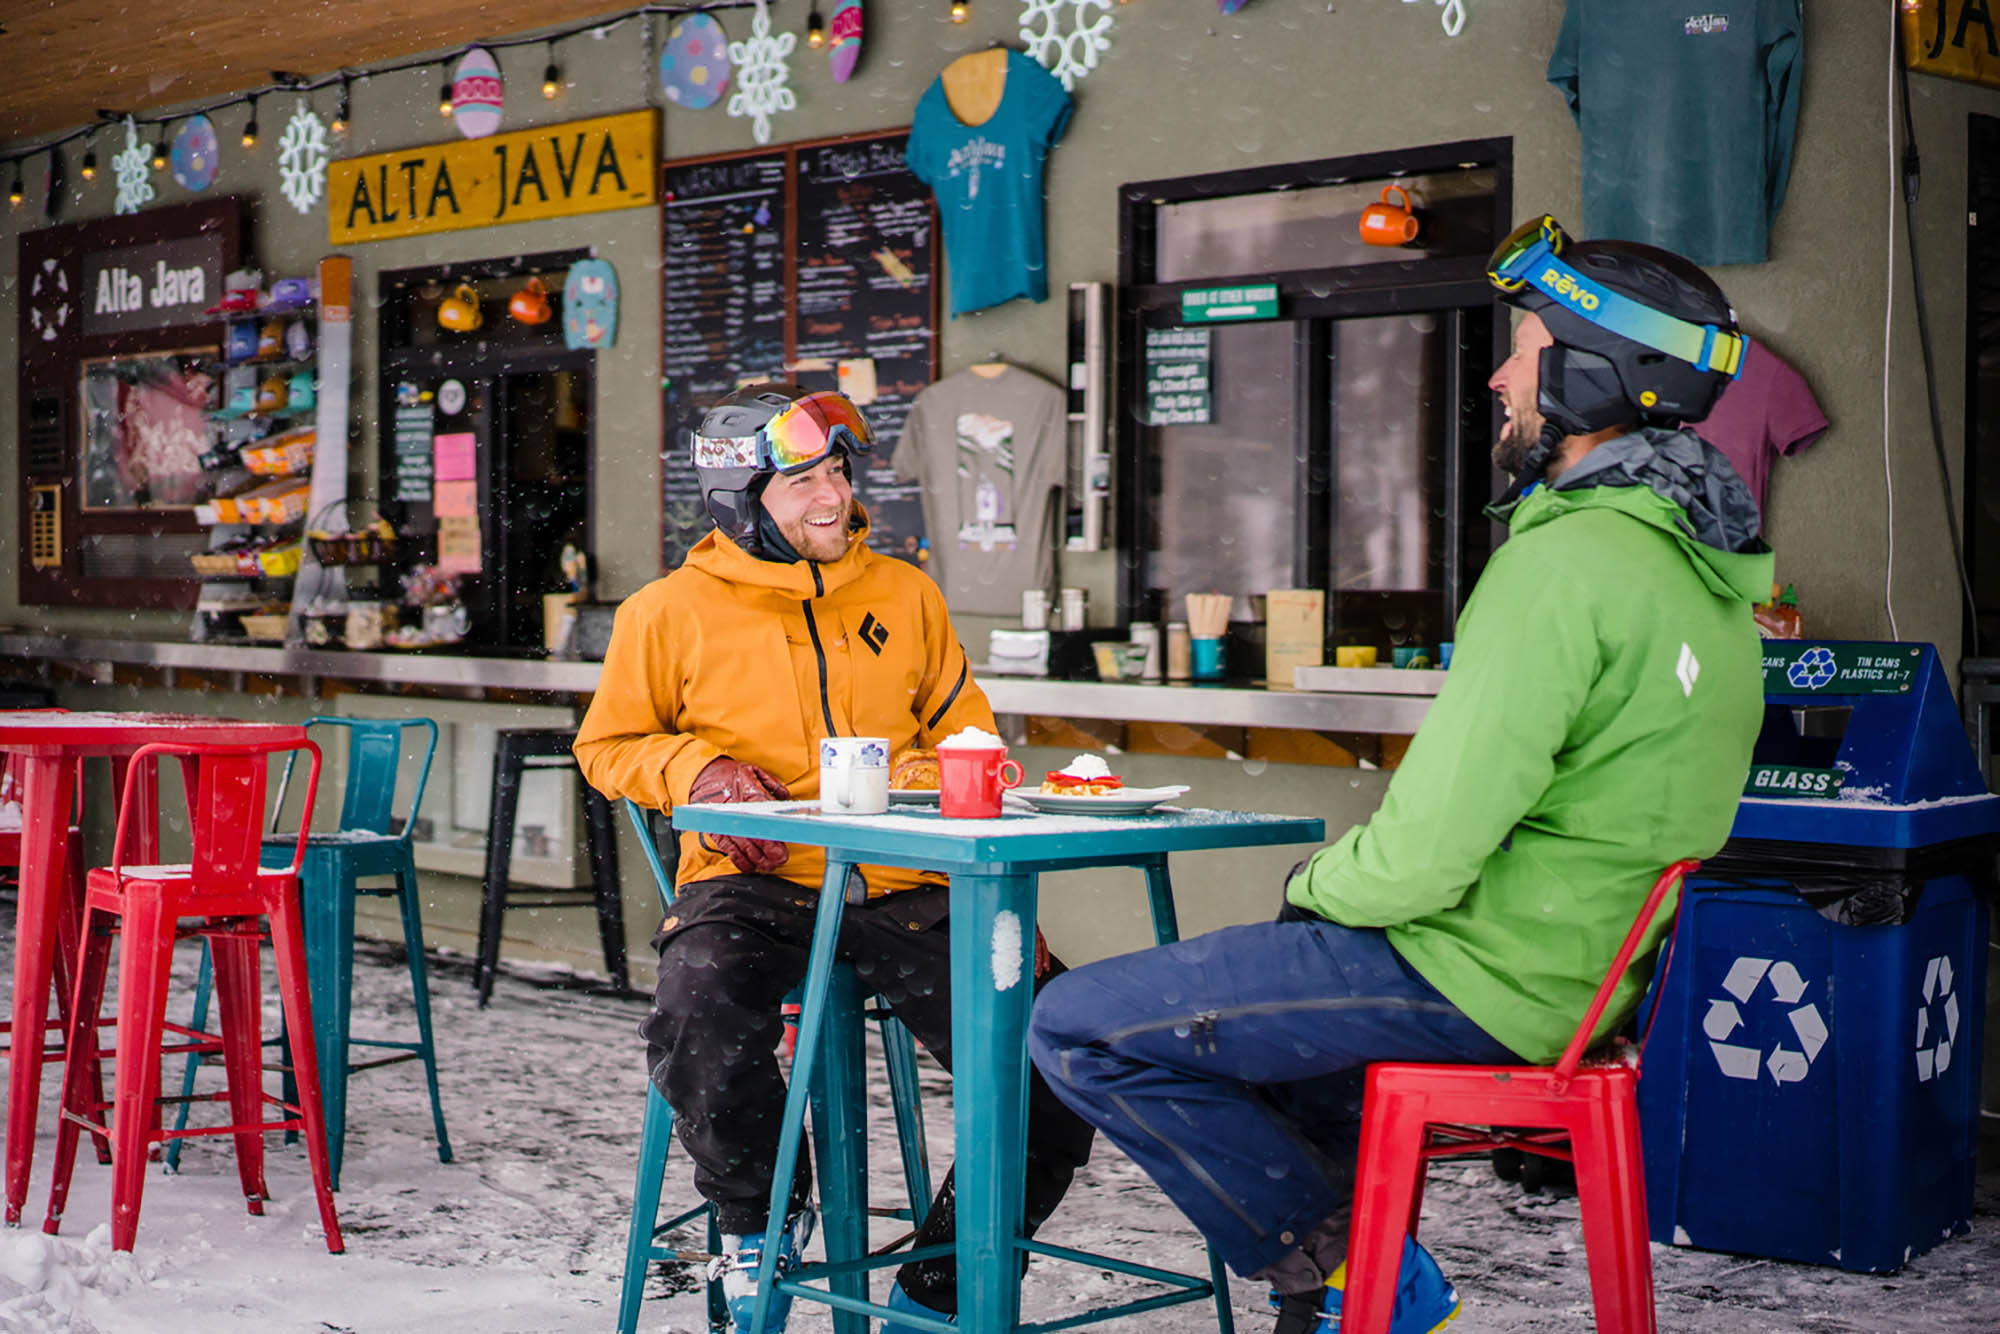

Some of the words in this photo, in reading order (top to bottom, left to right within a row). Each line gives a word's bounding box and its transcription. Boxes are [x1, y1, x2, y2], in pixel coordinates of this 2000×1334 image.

[346, 156, 460, 229] ALTA
[494, 132, 628, 219] JAVA
[95, 268, 143, 315] Alta
[150, 259, 205, 308] Java
[1857, 656, 1872, 668] TIN
[1874, 657, 1900, 669] CANS
[1840, 668, 1883, 681] PLASTICS
[1754, 769, 1831, 791] GLASS
